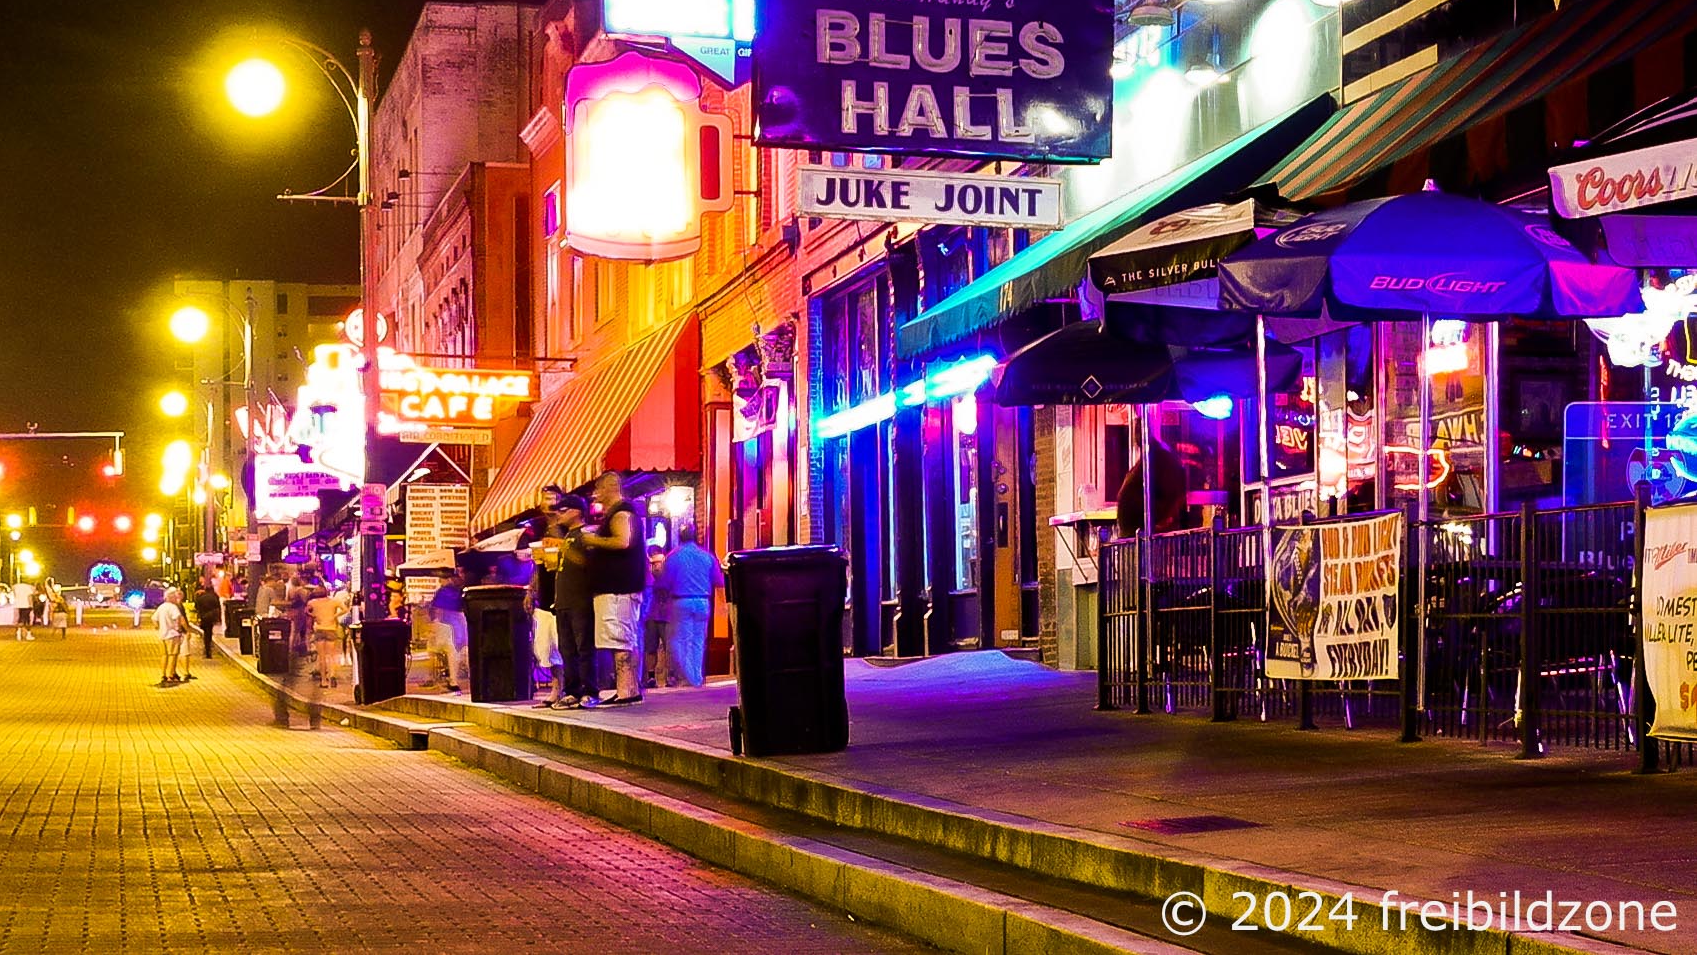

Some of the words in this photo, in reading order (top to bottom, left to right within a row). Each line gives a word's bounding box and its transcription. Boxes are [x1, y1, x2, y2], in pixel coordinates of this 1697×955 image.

[699, 46, 731, 57] GREAT
[815, 8, 1066, 80] BLUES
[840, 79, 1036, 144] HALL
[815, 176, 911, 210] JUKE
[934, 183, 1043, 218] JOINT
[1575, 166, 1664, 211] Coors
[1121, 270, 1143, 283] THE
[1148, 263, 1188, 279] SILVER
[1369, 276, 1425, 290] BUD
[1435, 279, 1507, 294] LIGHT
[400, 394, 494, 420] CAFE
[1606, 413, 1652, 429] EXIT
[1321, 527, 1341, 561] BUD
[1653, 540, 1689, 570] Miller
[1668, 623, 1694, 647] LITE,
[1326, 638, 1390, 679] EVERYDAY!
